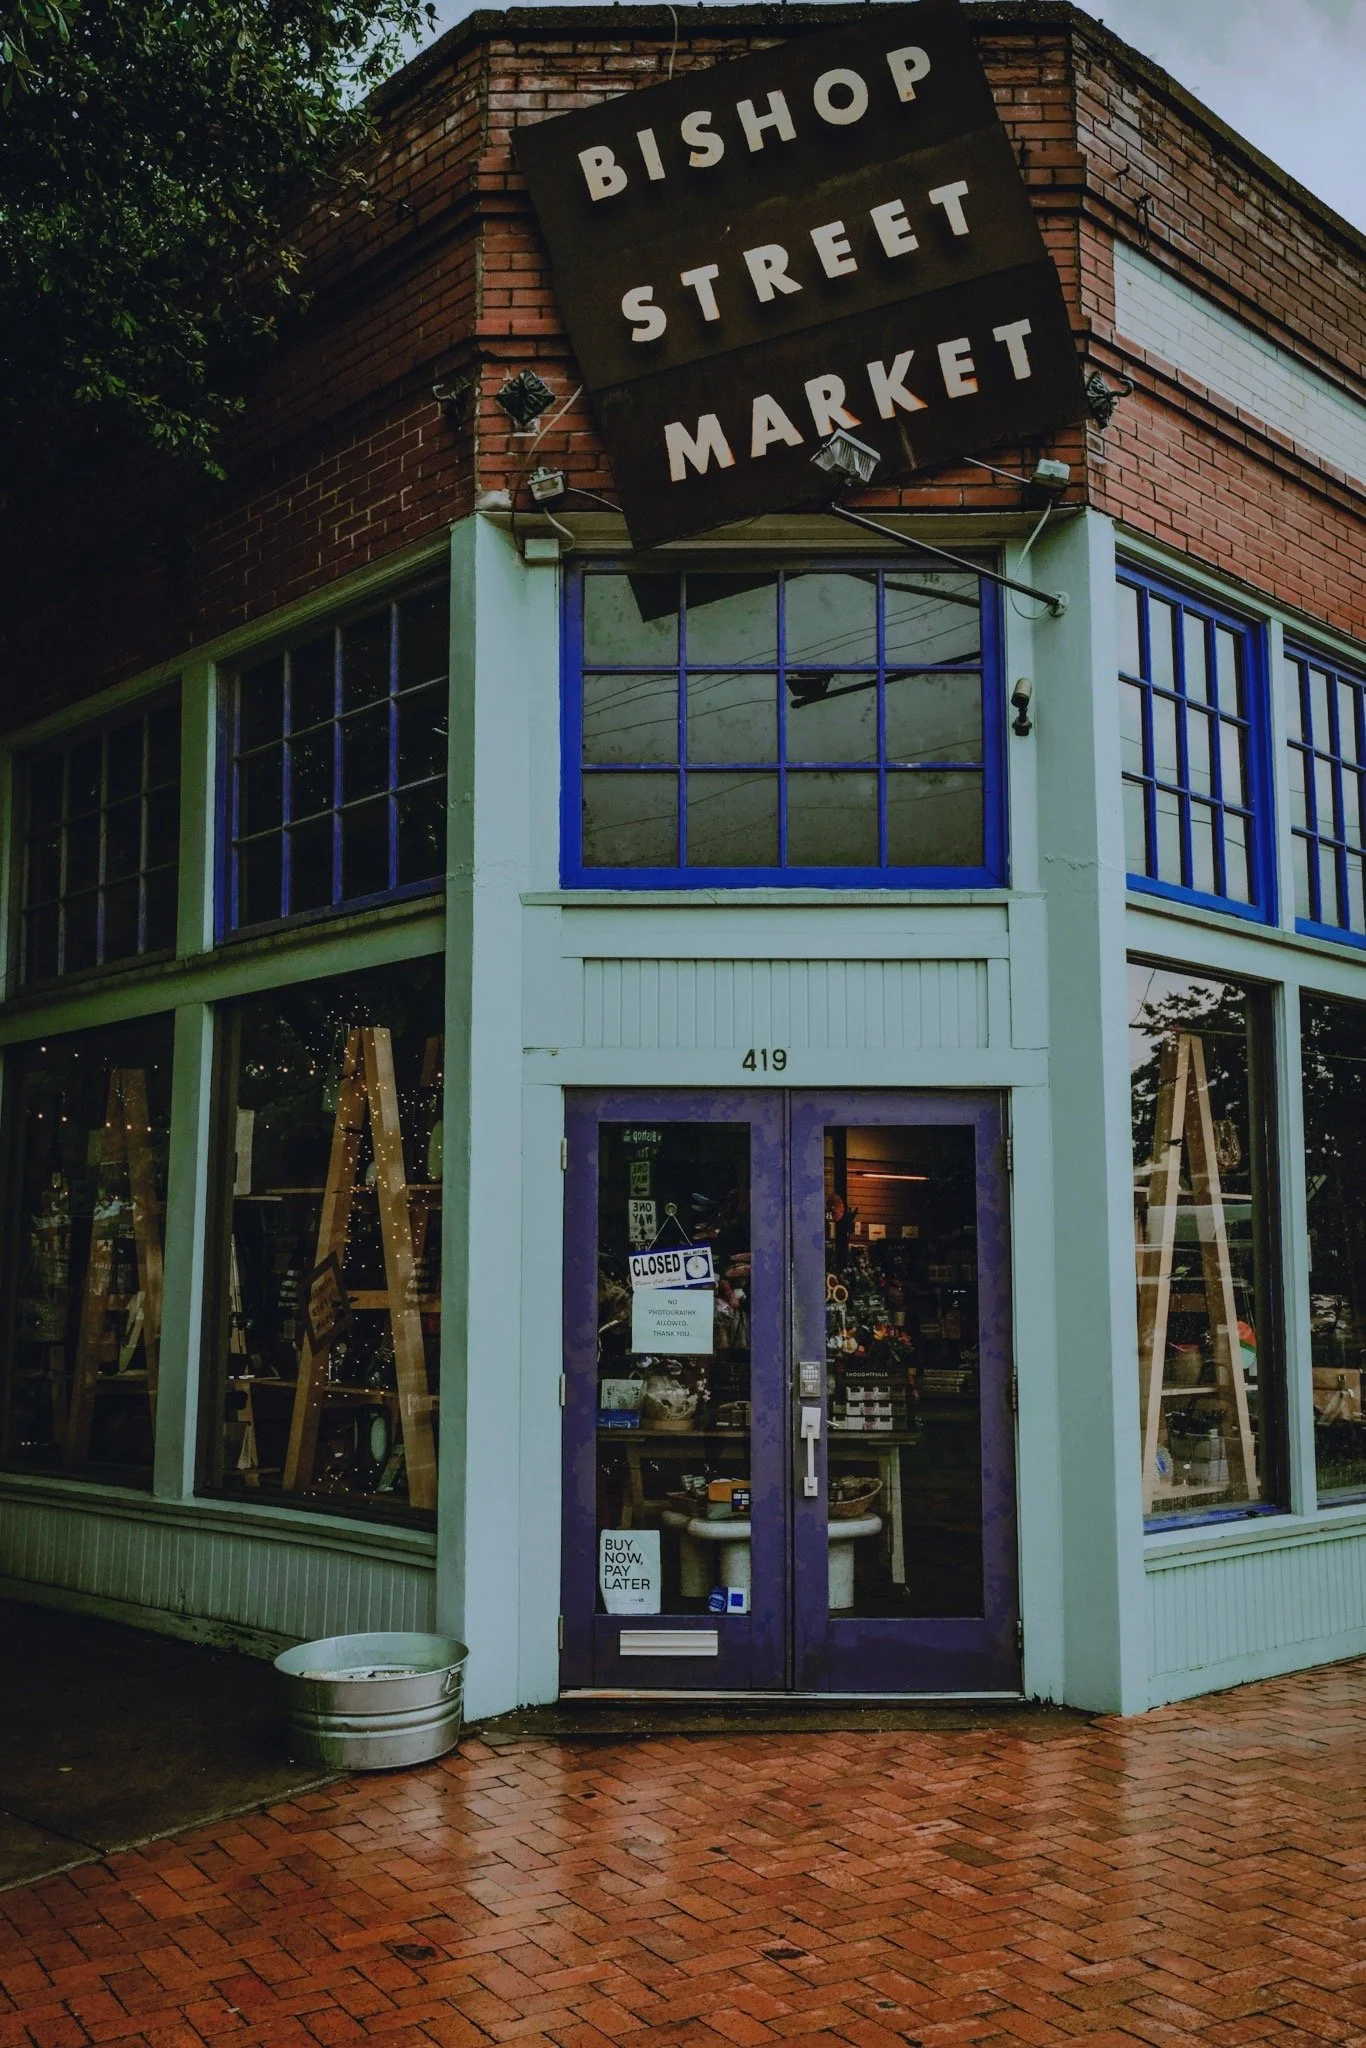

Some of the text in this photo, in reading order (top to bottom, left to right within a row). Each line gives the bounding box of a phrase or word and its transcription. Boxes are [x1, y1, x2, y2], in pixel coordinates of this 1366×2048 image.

[577, 46, 931, 203] BISHOP
[621, 180, 971, 344] STREET
[664, 318, 1034, 483] MARKET
[743, 1048, 787, 1072] 419
[633, 1254, 681, 1277] CLOSED
[605, 1539, 633, 1550] BUY
[604, 1552, 643, 1565] NOW,
[605, 1565, 631, 1576] PAY
[604, 1578, 650, 1590] LATER
